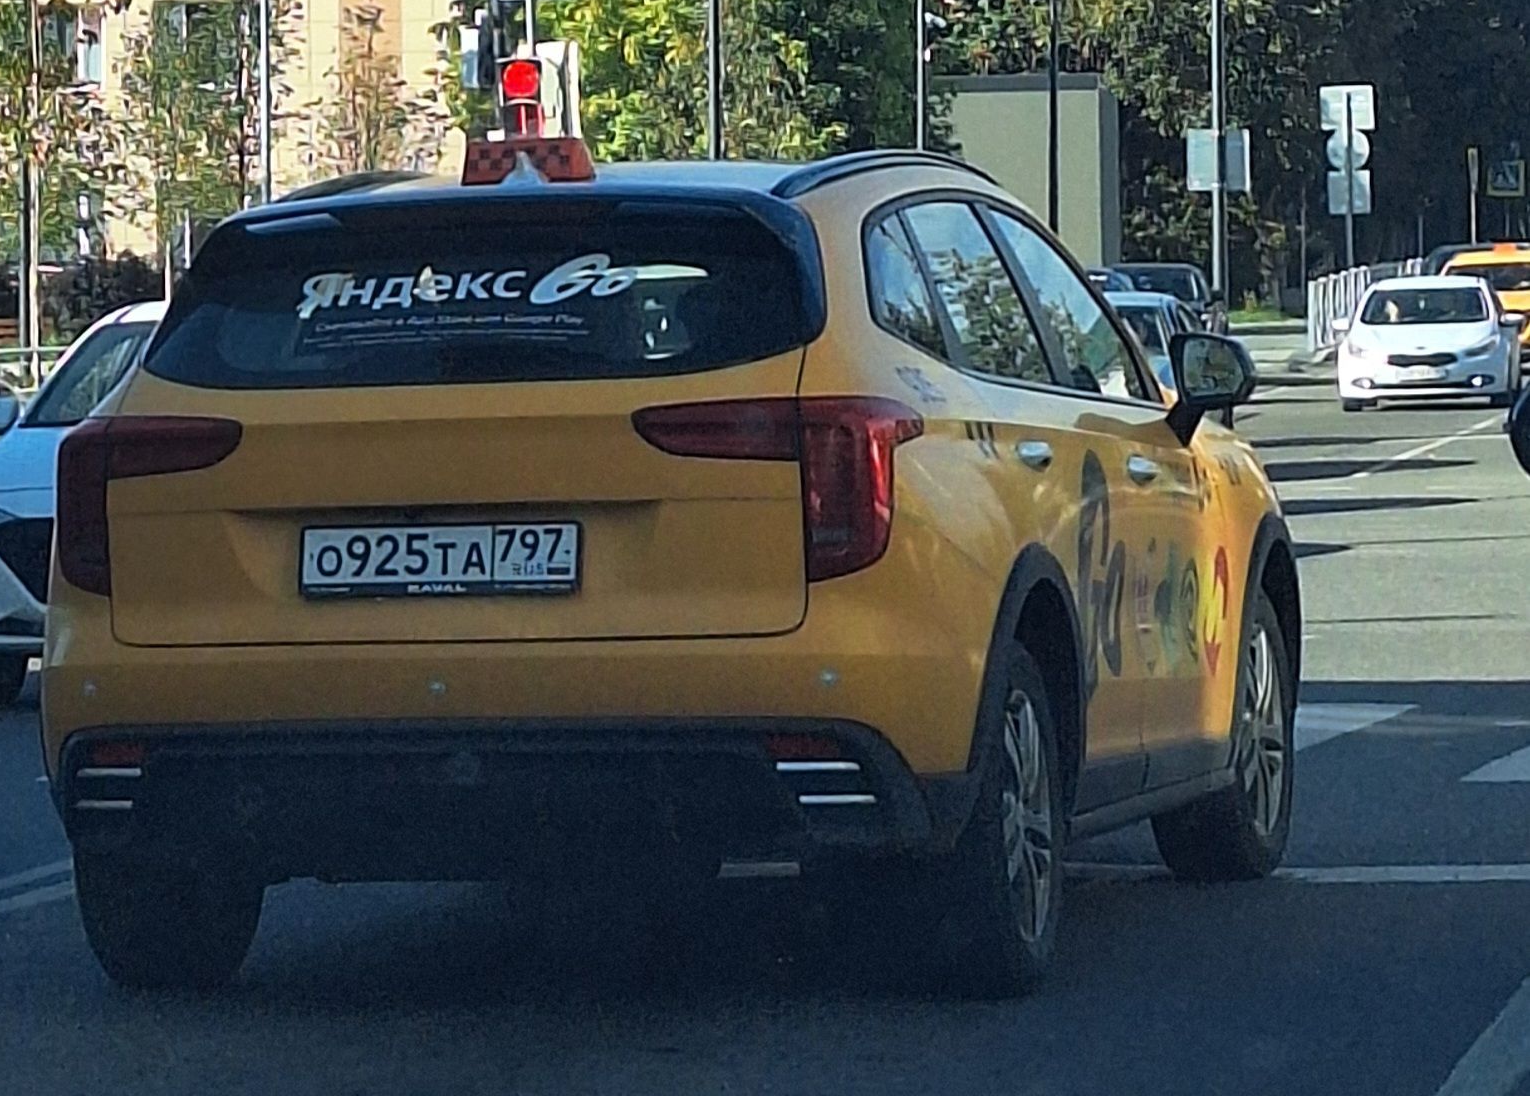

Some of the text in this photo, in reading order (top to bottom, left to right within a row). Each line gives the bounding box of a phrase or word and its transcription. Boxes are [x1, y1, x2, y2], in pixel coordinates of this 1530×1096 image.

[296, 254, 639, 319] Яндекс Go
[496, 528, 563, 563] 797
